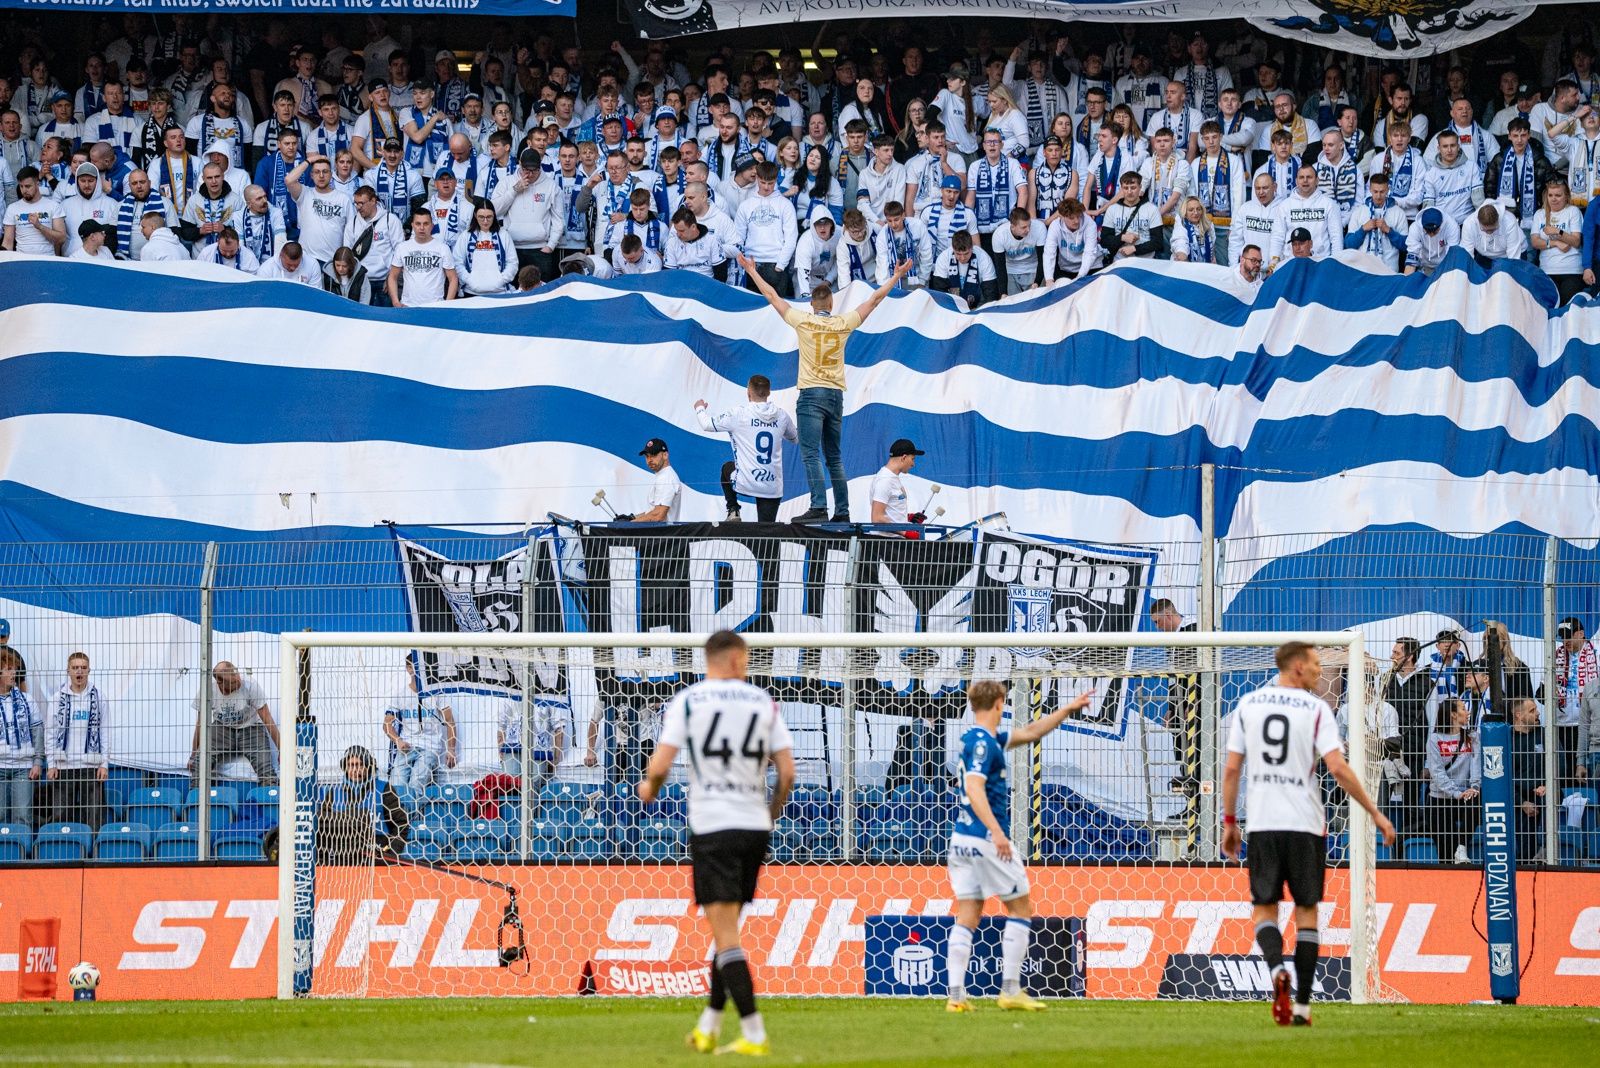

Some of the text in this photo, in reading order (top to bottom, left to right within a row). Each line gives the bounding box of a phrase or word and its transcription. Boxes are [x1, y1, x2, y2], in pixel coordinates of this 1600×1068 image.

[759, 1, 796, 15] AVE
[404, 255, 442, 268] MISTRZ
[812, 332, 840, 367] 12
[751, 418, 778, 428] ISHAK
[755, 431, 774, 465] 9
[751, 468, 777, 482] Pils
[985, 543, 1130, 605] OGÓR
[1012, 589, 1048, 598] KKS LECH
[702, 711, 765, 768] 44
[1263, 714, 1290, 765] 9
[295, 801, 313, 844] LECH
[1484, 801, 1507, 846] LECH
[1487, 851, 1511, 922] POZNAŃ
[117, 899, 501, 970] STIHL
[25, 947, 57, 973] STIHL
[609, 966, 712, 995] SUPERBET
